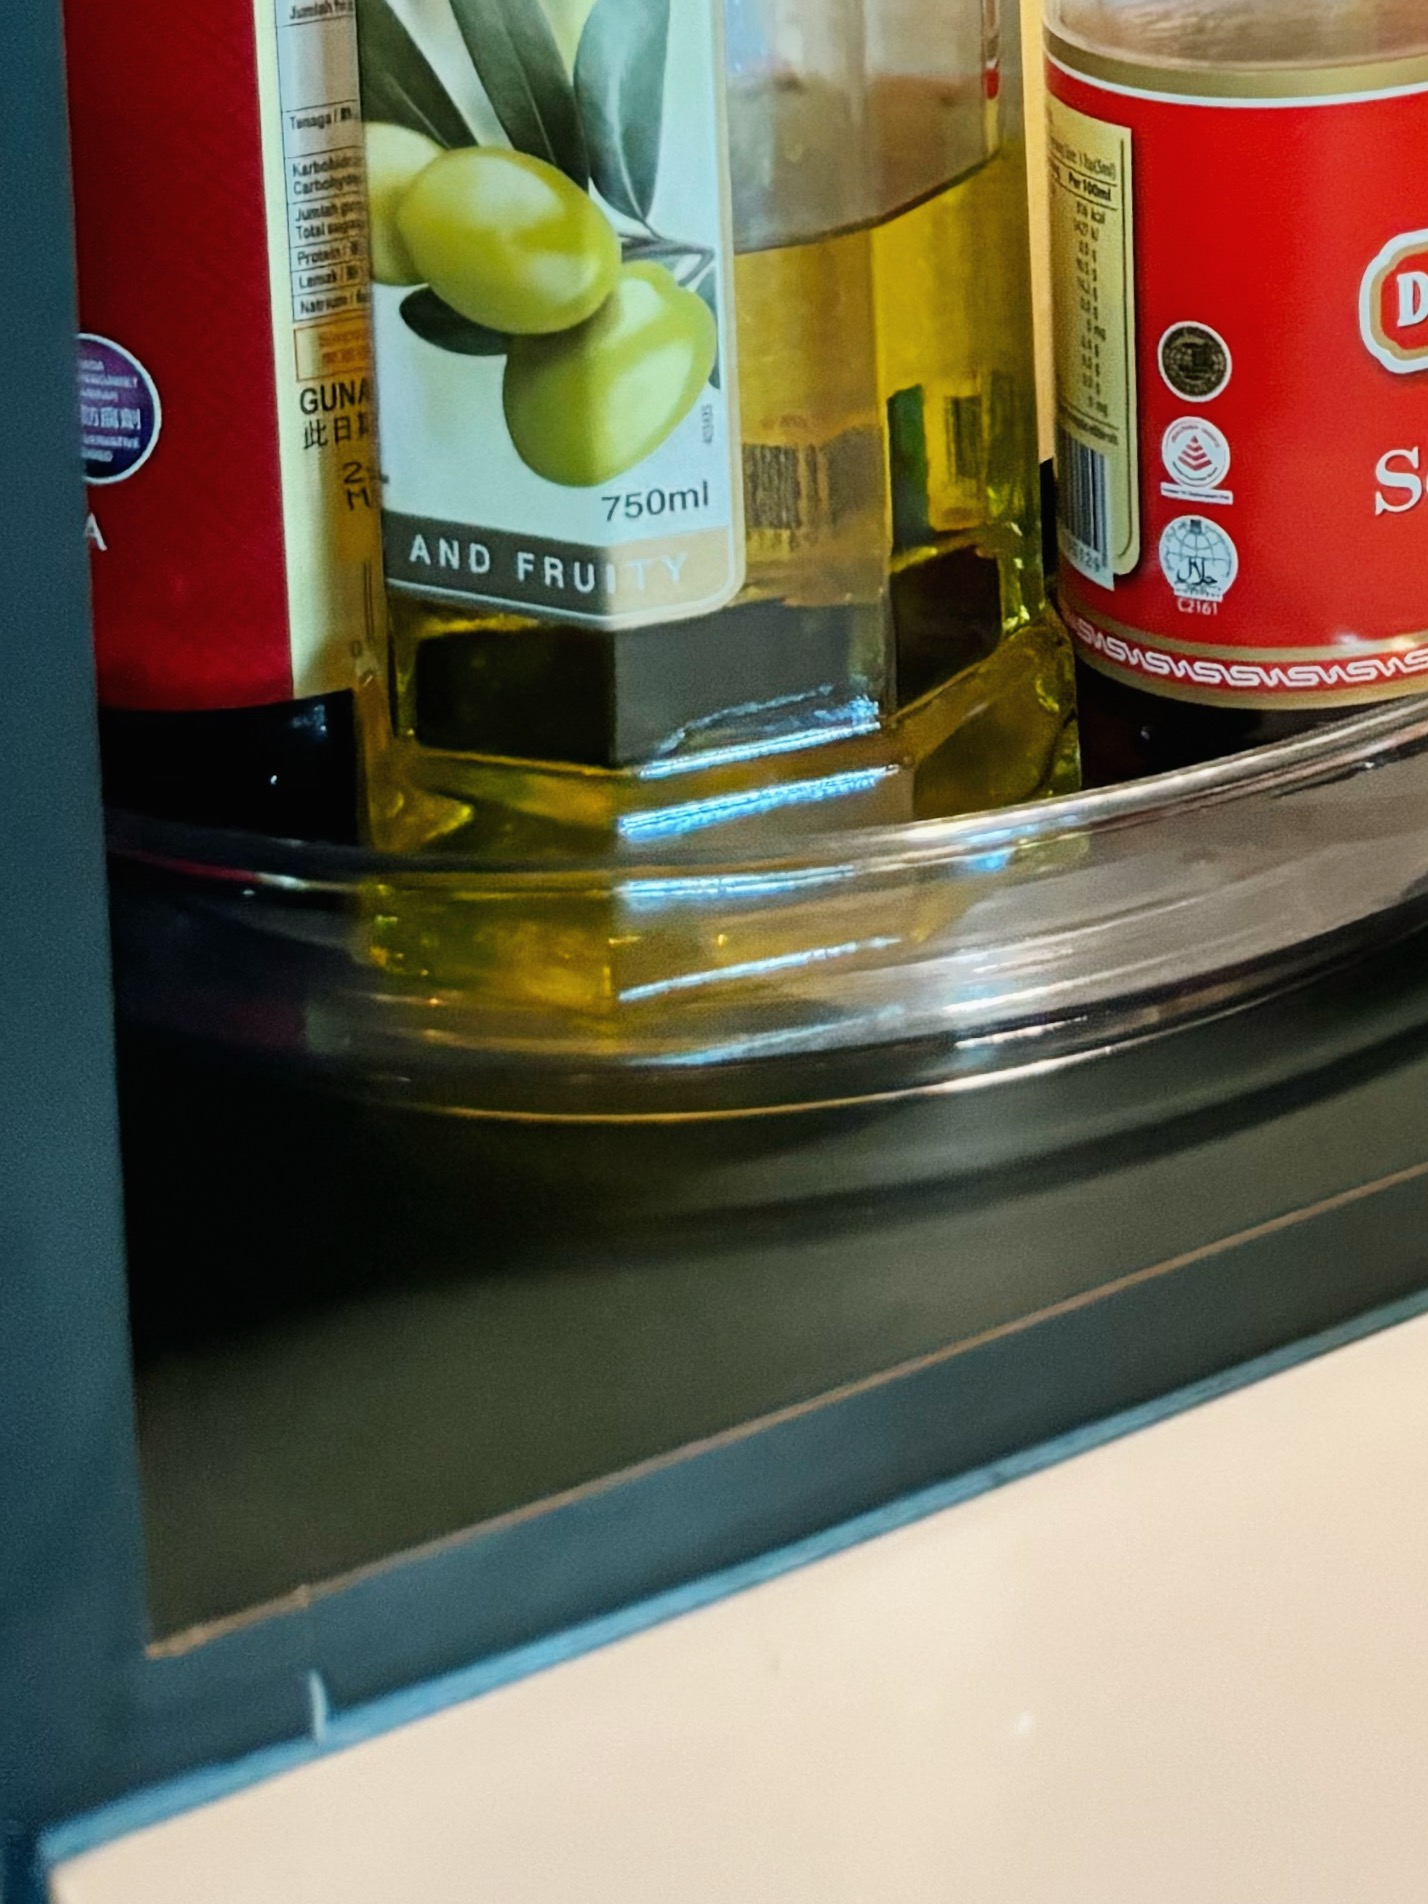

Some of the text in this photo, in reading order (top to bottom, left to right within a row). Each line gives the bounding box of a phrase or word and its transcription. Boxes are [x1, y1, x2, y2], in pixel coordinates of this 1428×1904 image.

[601, 480, 709, 523] 750ml
[409, 533, 689, 594] AND FRUITY
